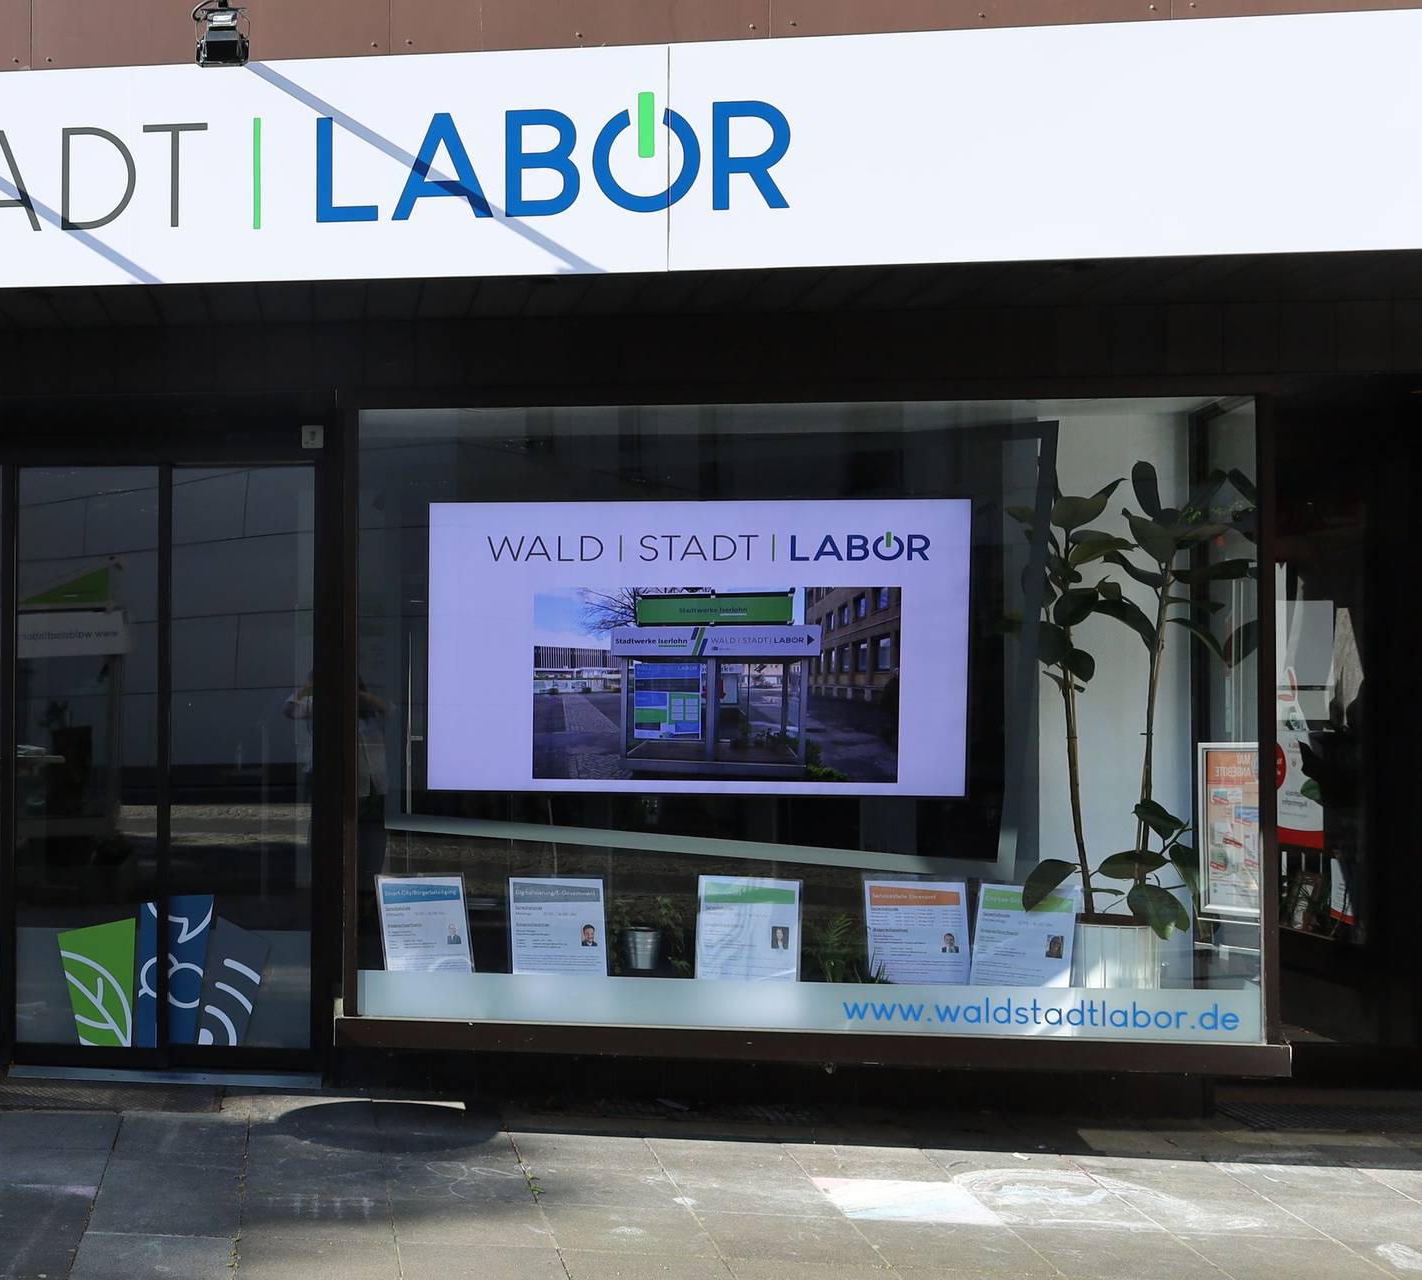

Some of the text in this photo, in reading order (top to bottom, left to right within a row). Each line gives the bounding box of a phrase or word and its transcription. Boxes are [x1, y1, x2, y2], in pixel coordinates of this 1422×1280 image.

[316, 91, 791, 224] LABOR
[487, 531, 931, 562] WALD STADT LABOR
[842, 997, 1240, 1032] www.waldstadtlabor.de
